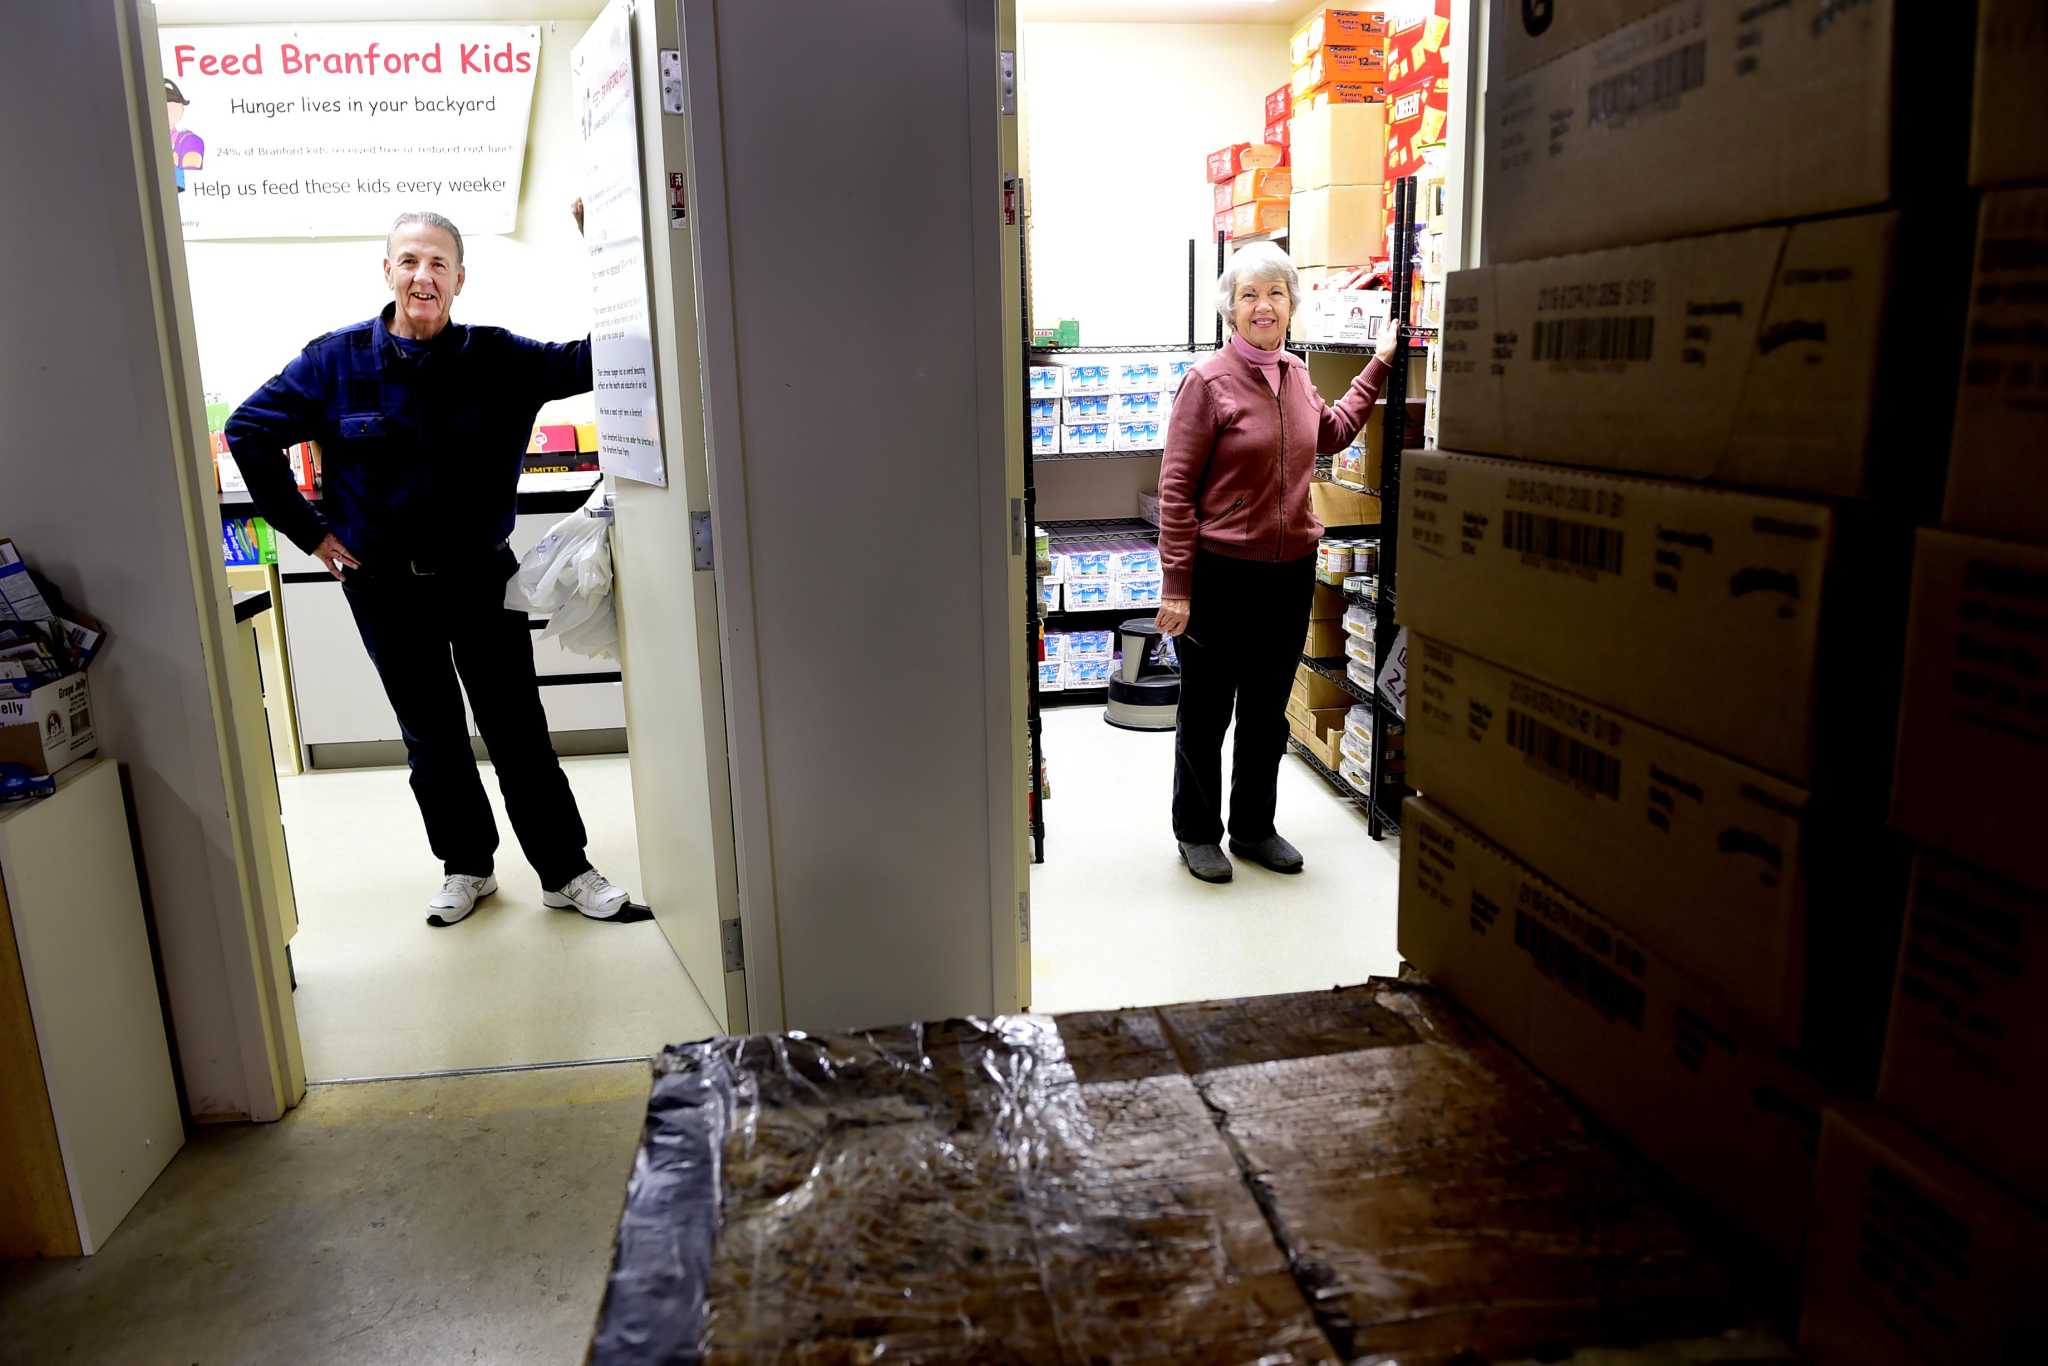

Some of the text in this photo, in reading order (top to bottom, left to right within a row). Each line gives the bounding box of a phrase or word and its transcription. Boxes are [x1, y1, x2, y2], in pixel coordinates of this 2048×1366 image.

[174, 41, 532, 78] Feed Branford Kids
[231, 95, 496, 119] Hunger lives in your backyard
[193, 180, 231, 200] Help
[237, 183, 257, 196] us
[262, 179, 300, 195] feed
[305, 178, 351, 194] these
[357, 178, 391, 193] kids
[396, 181, 442, 196] every
[522, 466, 569, 474] LIMITED
